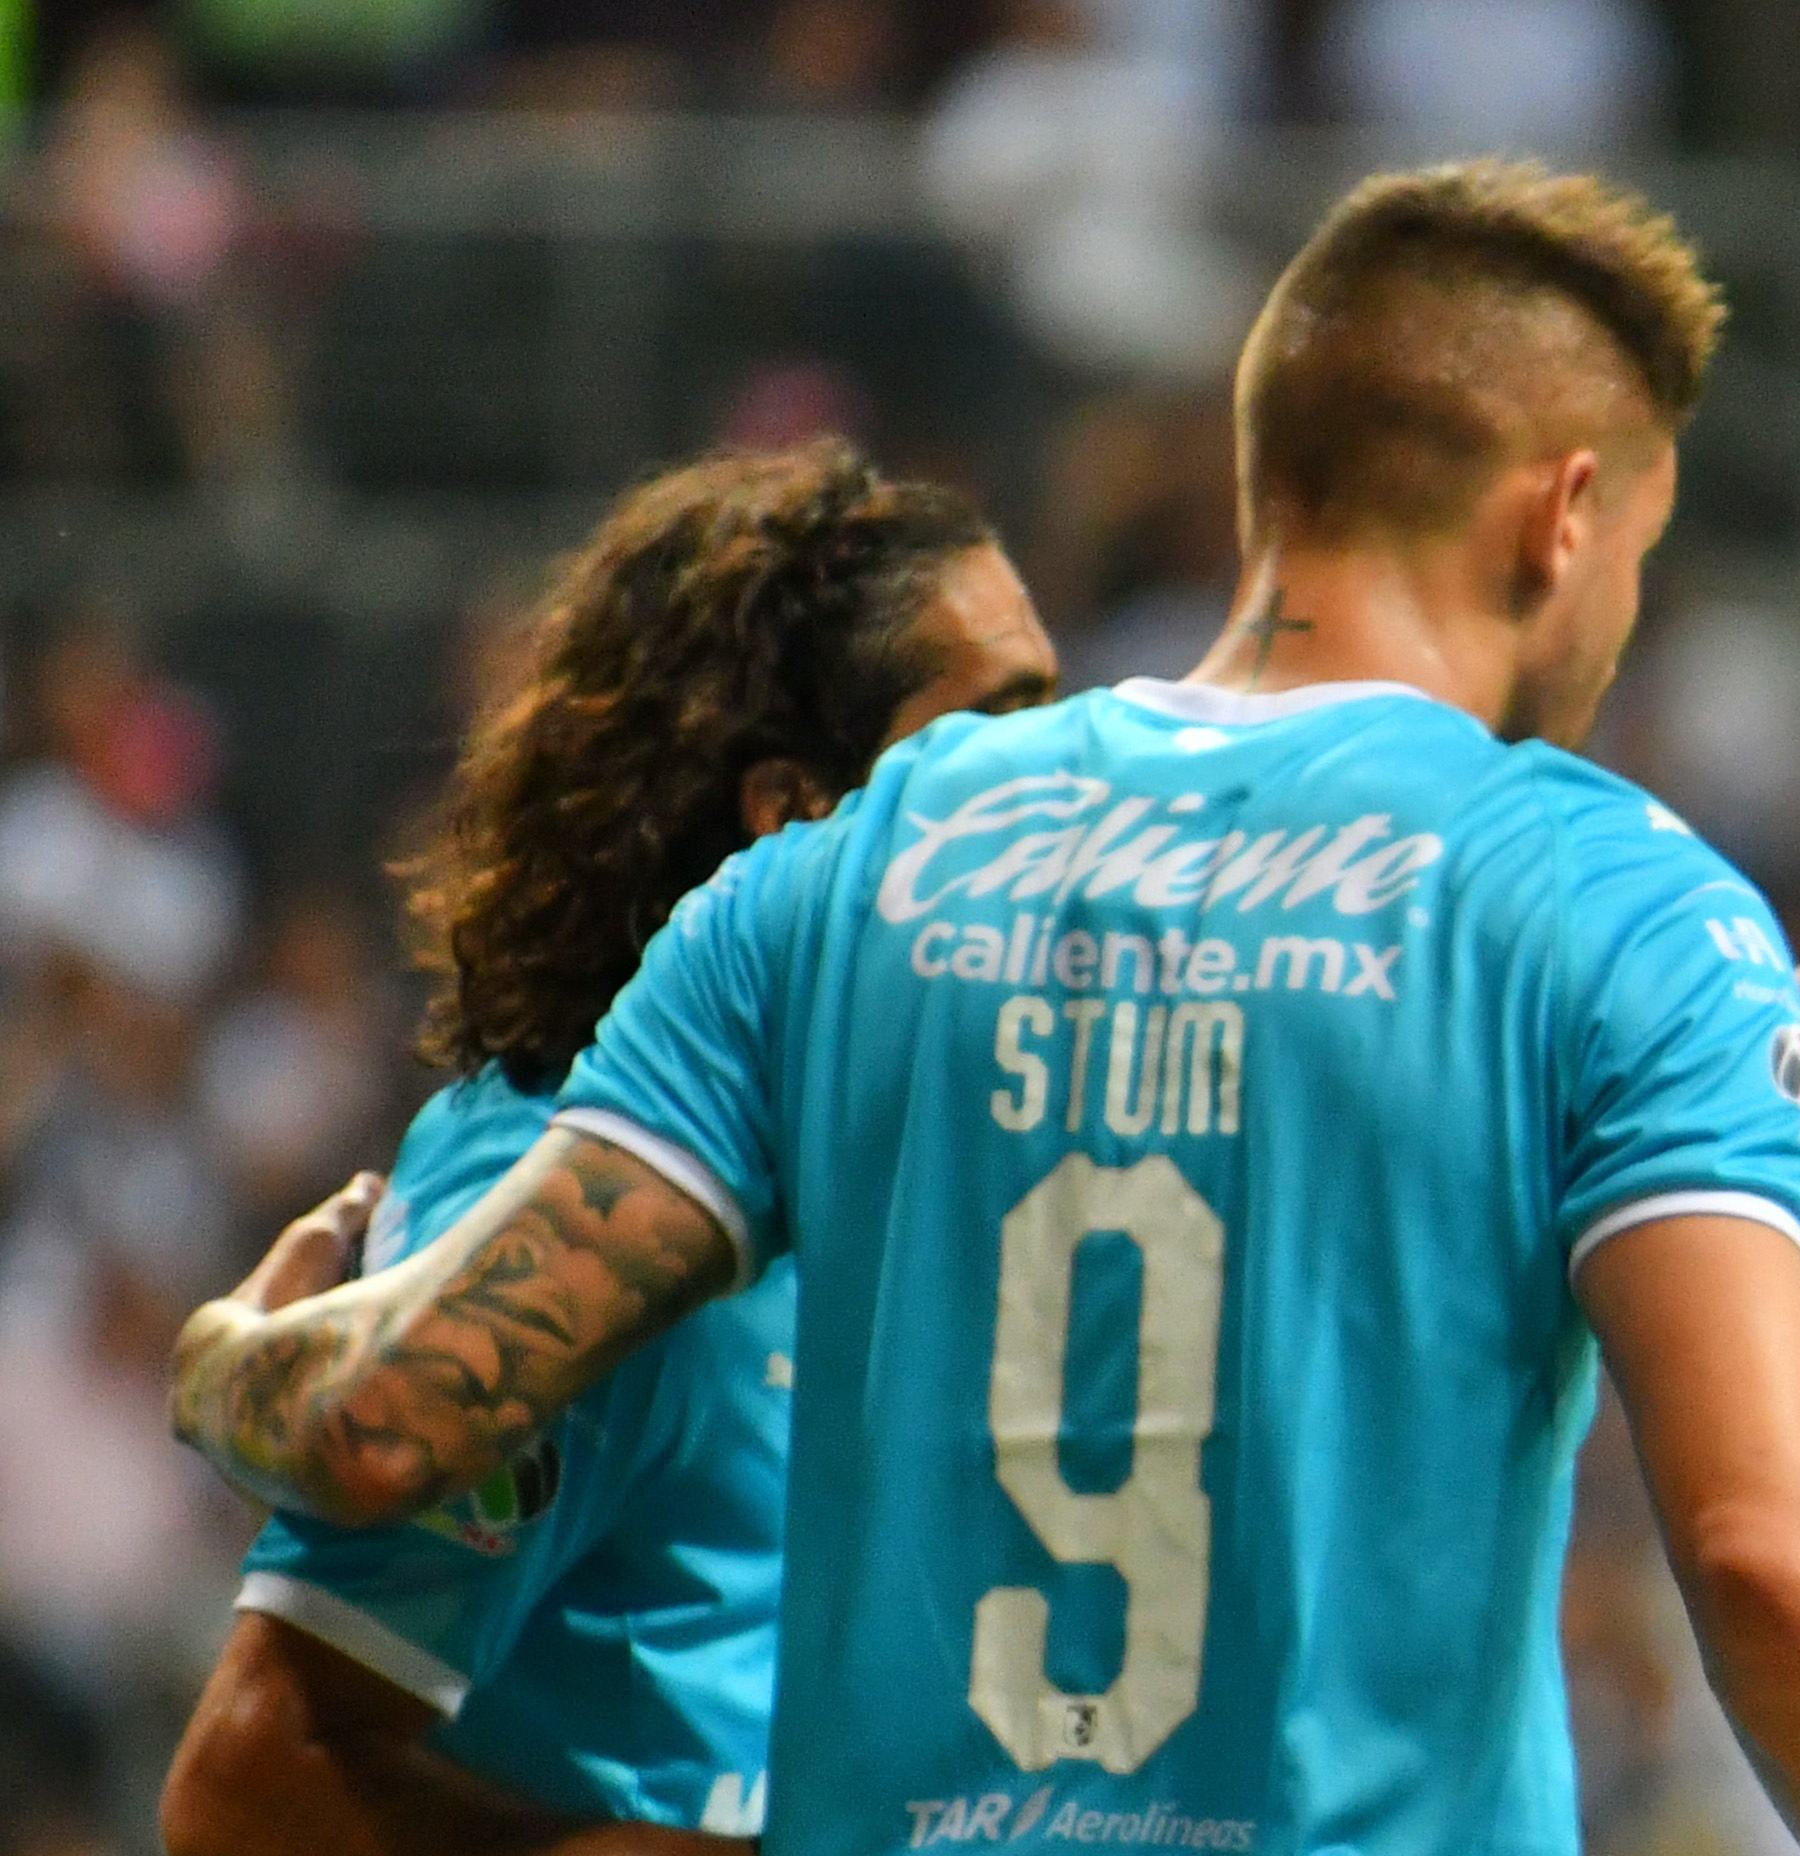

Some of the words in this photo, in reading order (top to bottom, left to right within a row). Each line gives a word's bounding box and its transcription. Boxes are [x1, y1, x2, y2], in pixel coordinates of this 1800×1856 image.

[877, 769, 1444, 925] Caliente
[910, 913, 1401, 999] caliente.mx
[989, 995, 1244, 1136] STUM
[968, 1152, 1224, 1775] 9
[905, 1792, 1013, 1849] TAR
